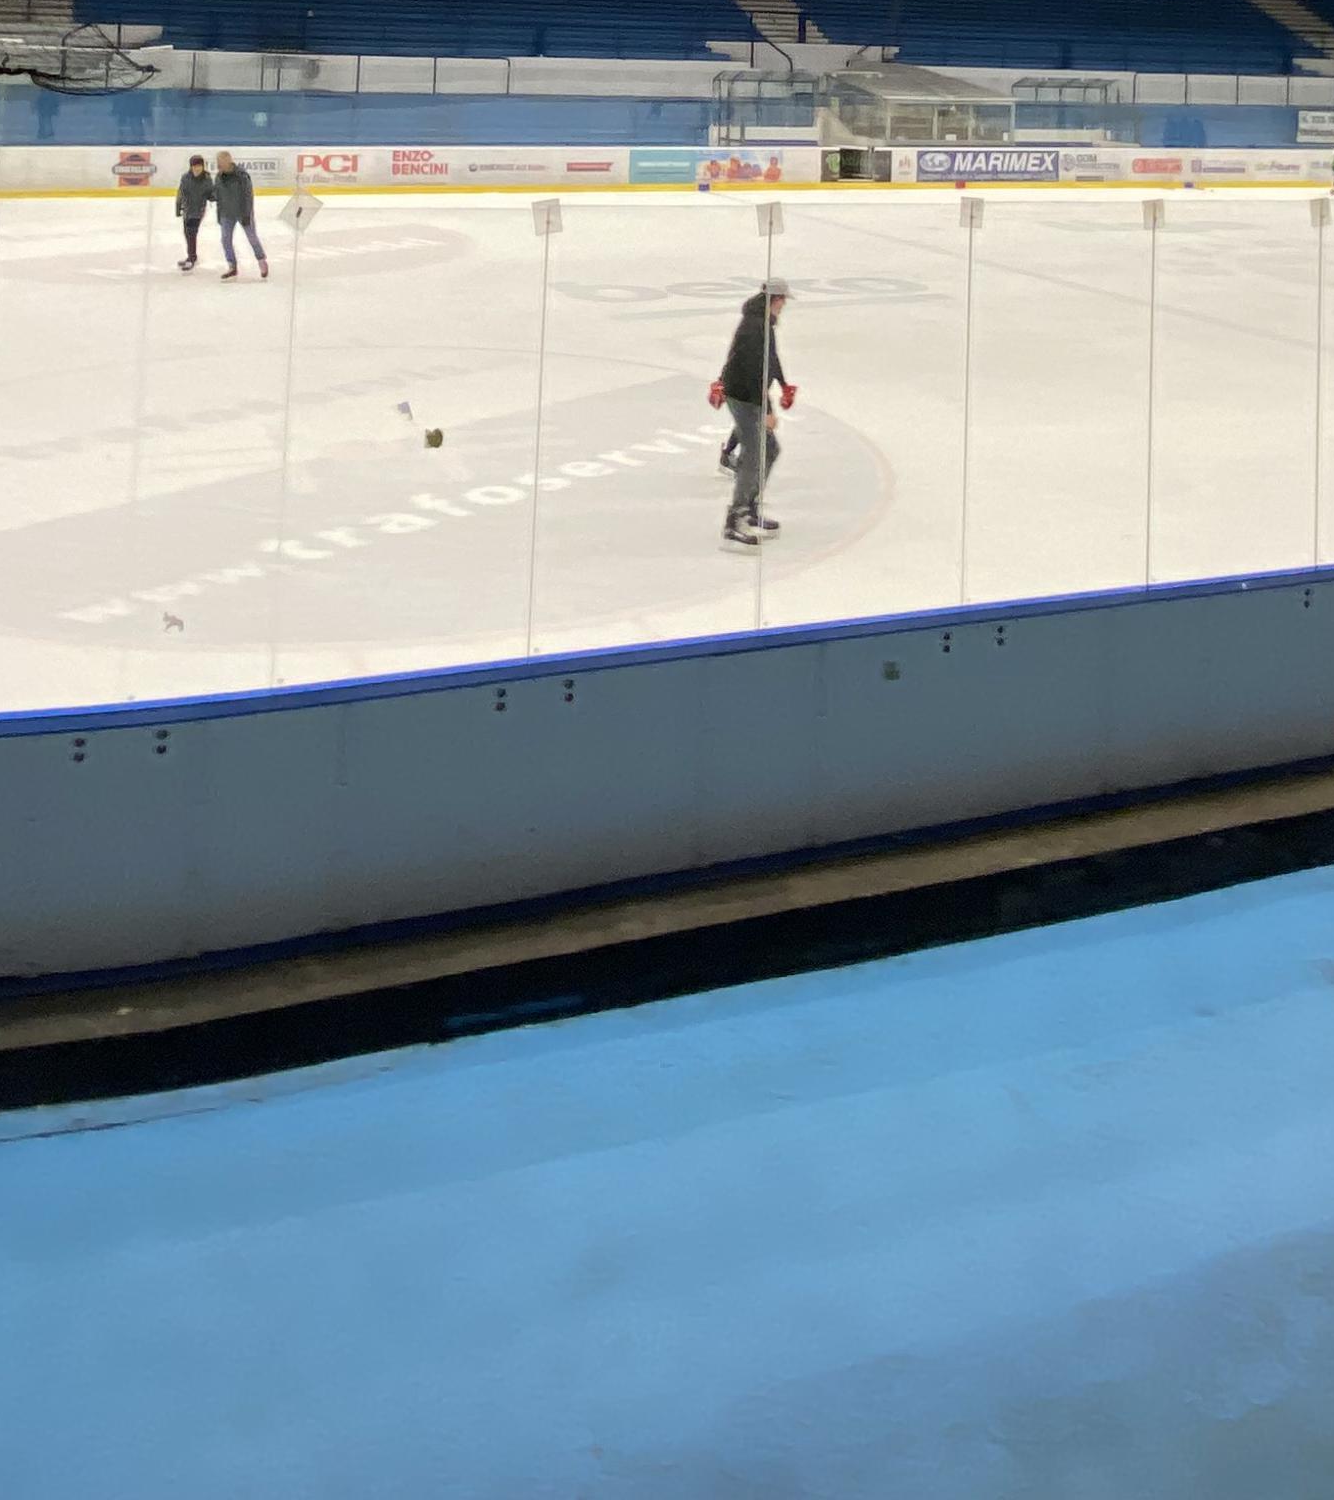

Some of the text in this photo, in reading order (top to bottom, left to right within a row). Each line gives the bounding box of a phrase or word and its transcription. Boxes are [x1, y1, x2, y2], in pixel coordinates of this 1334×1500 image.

[297, 154, 359, 173] PCI
[392, 163, 449, 176] BENCINI
[953, 152, 1057, 173] MARIMEX
